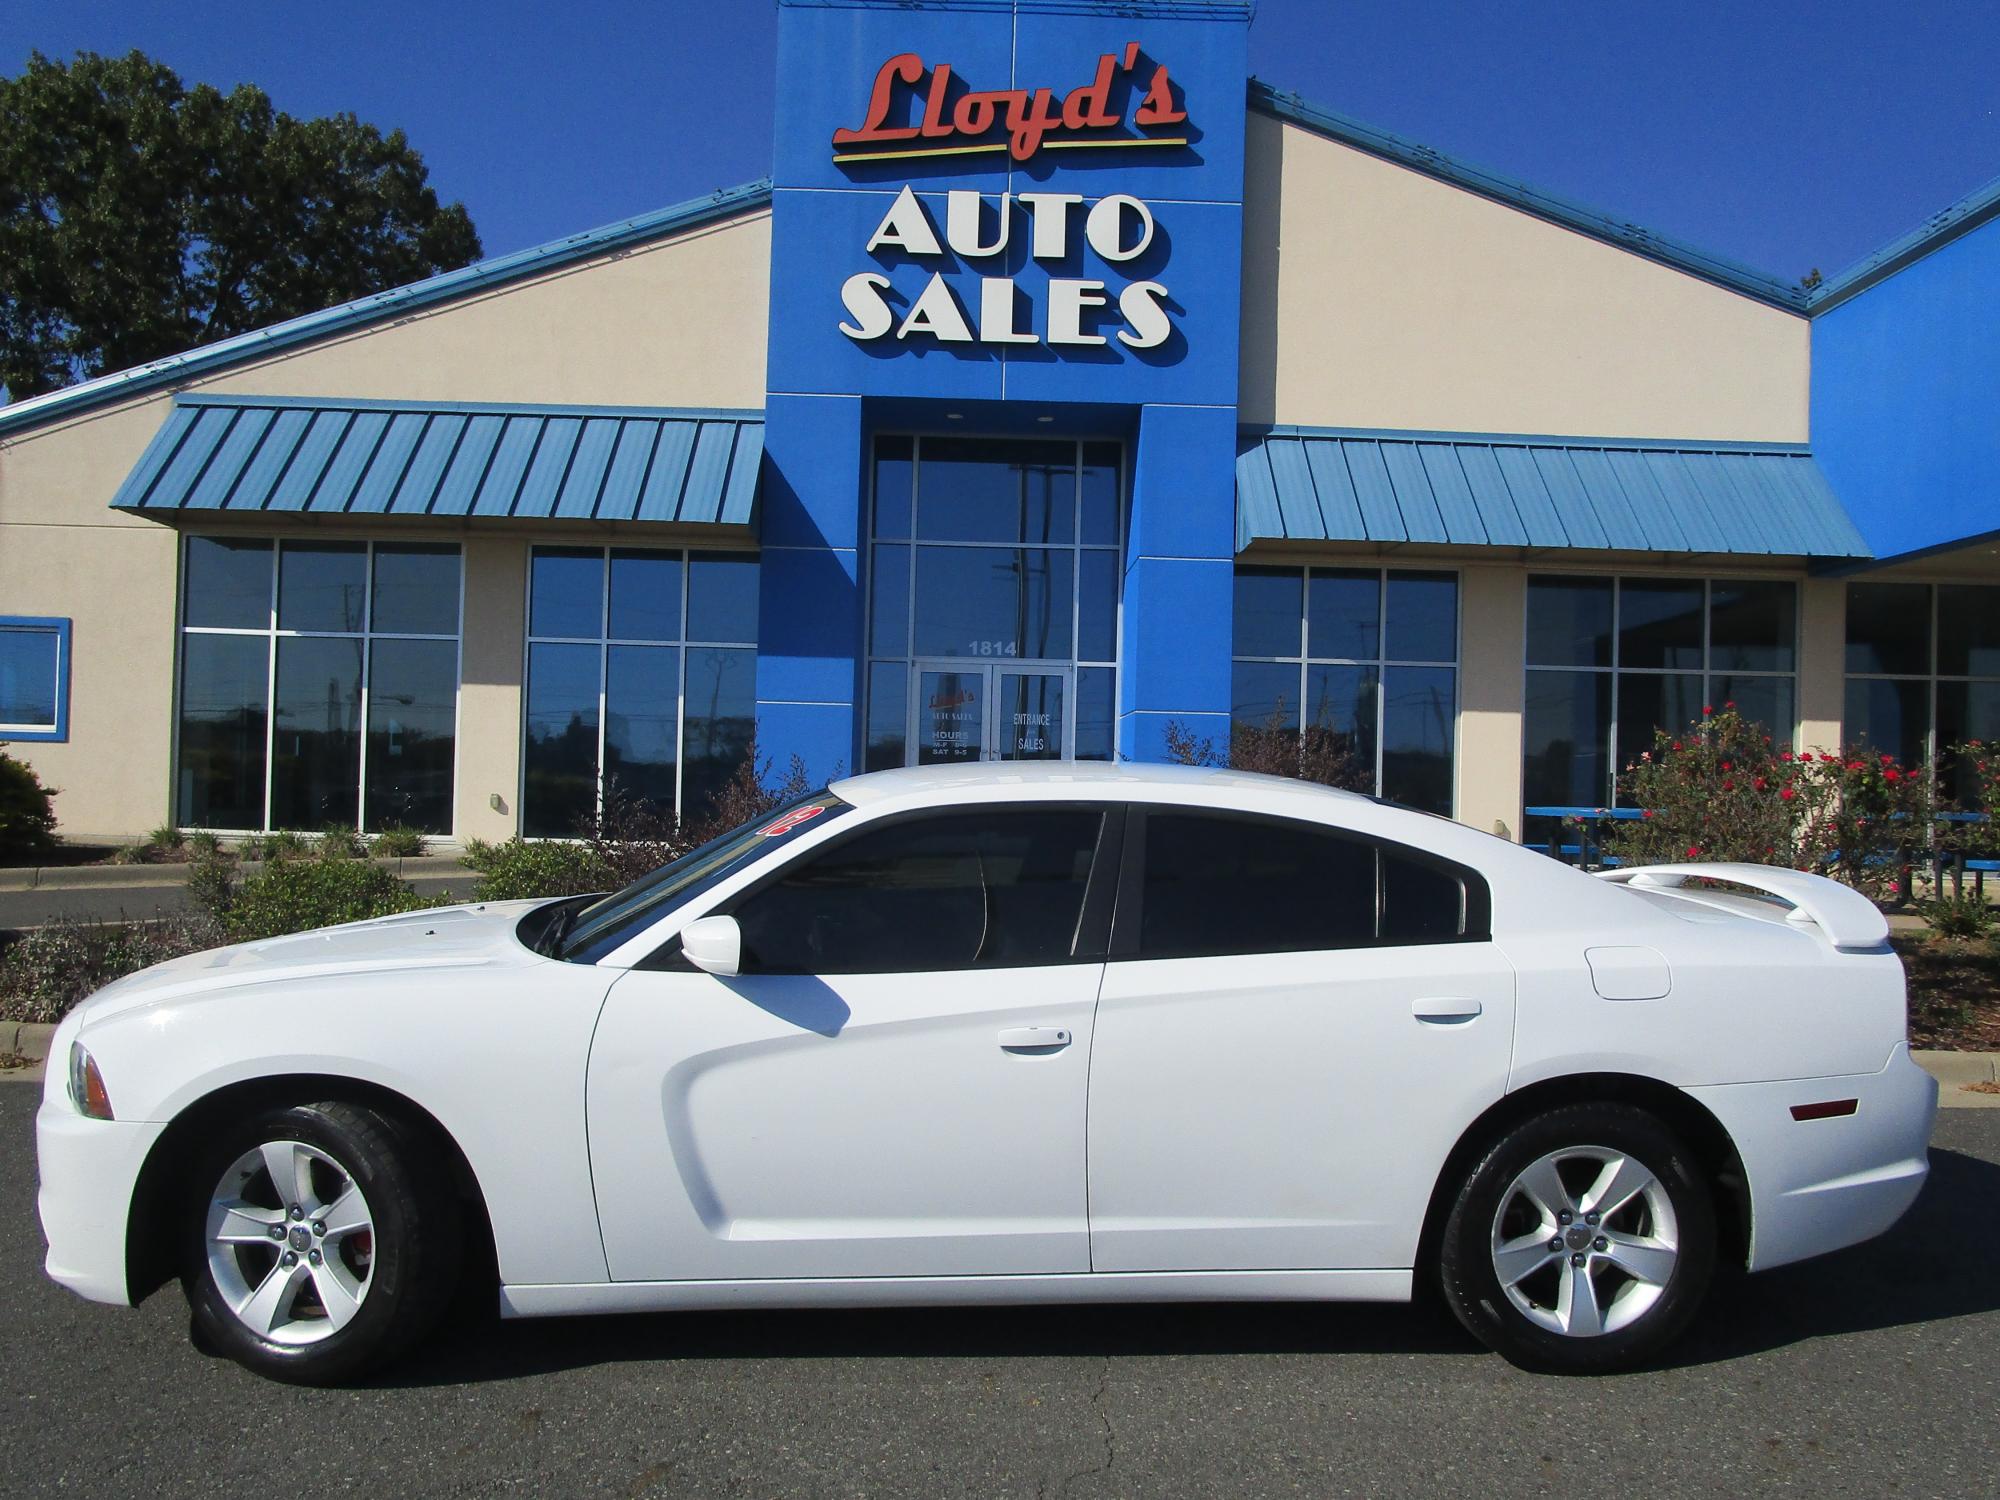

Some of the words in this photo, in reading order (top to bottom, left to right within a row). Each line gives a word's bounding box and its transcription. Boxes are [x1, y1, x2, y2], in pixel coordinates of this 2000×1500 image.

[832, 41, 1187, 160] Lloyd's
[866, 184, 1154, 261] AUTO
[838, 271, 1171, 348] SALES
[969, 640, 1016, 656] 1814
[1013, 713, 1050, 726] ENTRANCE
[932, 731, 968, 740] HOURS
[1018, 738, 1044, 751] SALES
